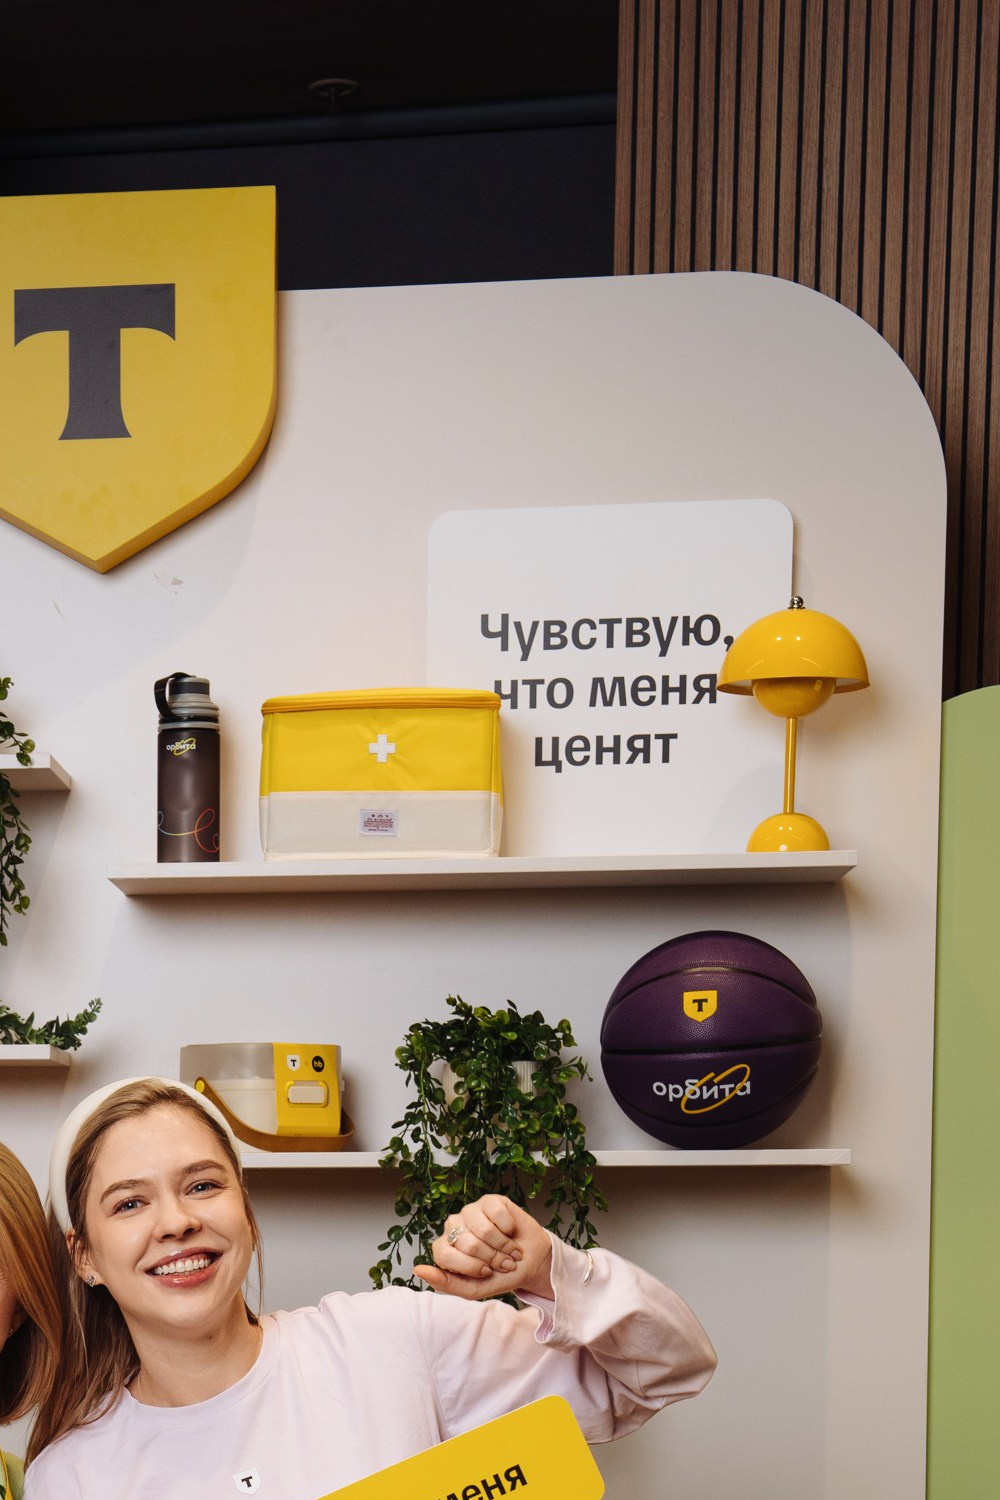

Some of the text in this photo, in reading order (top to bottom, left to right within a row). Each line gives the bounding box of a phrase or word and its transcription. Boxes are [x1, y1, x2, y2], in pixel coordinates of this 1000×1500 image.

[480, 613, 735, 661] Чувствую,
[494, 673, 718, 709] что меня
[534, 733, 678, 773] ценят
[652, 1079, 751, 1101] орбита
